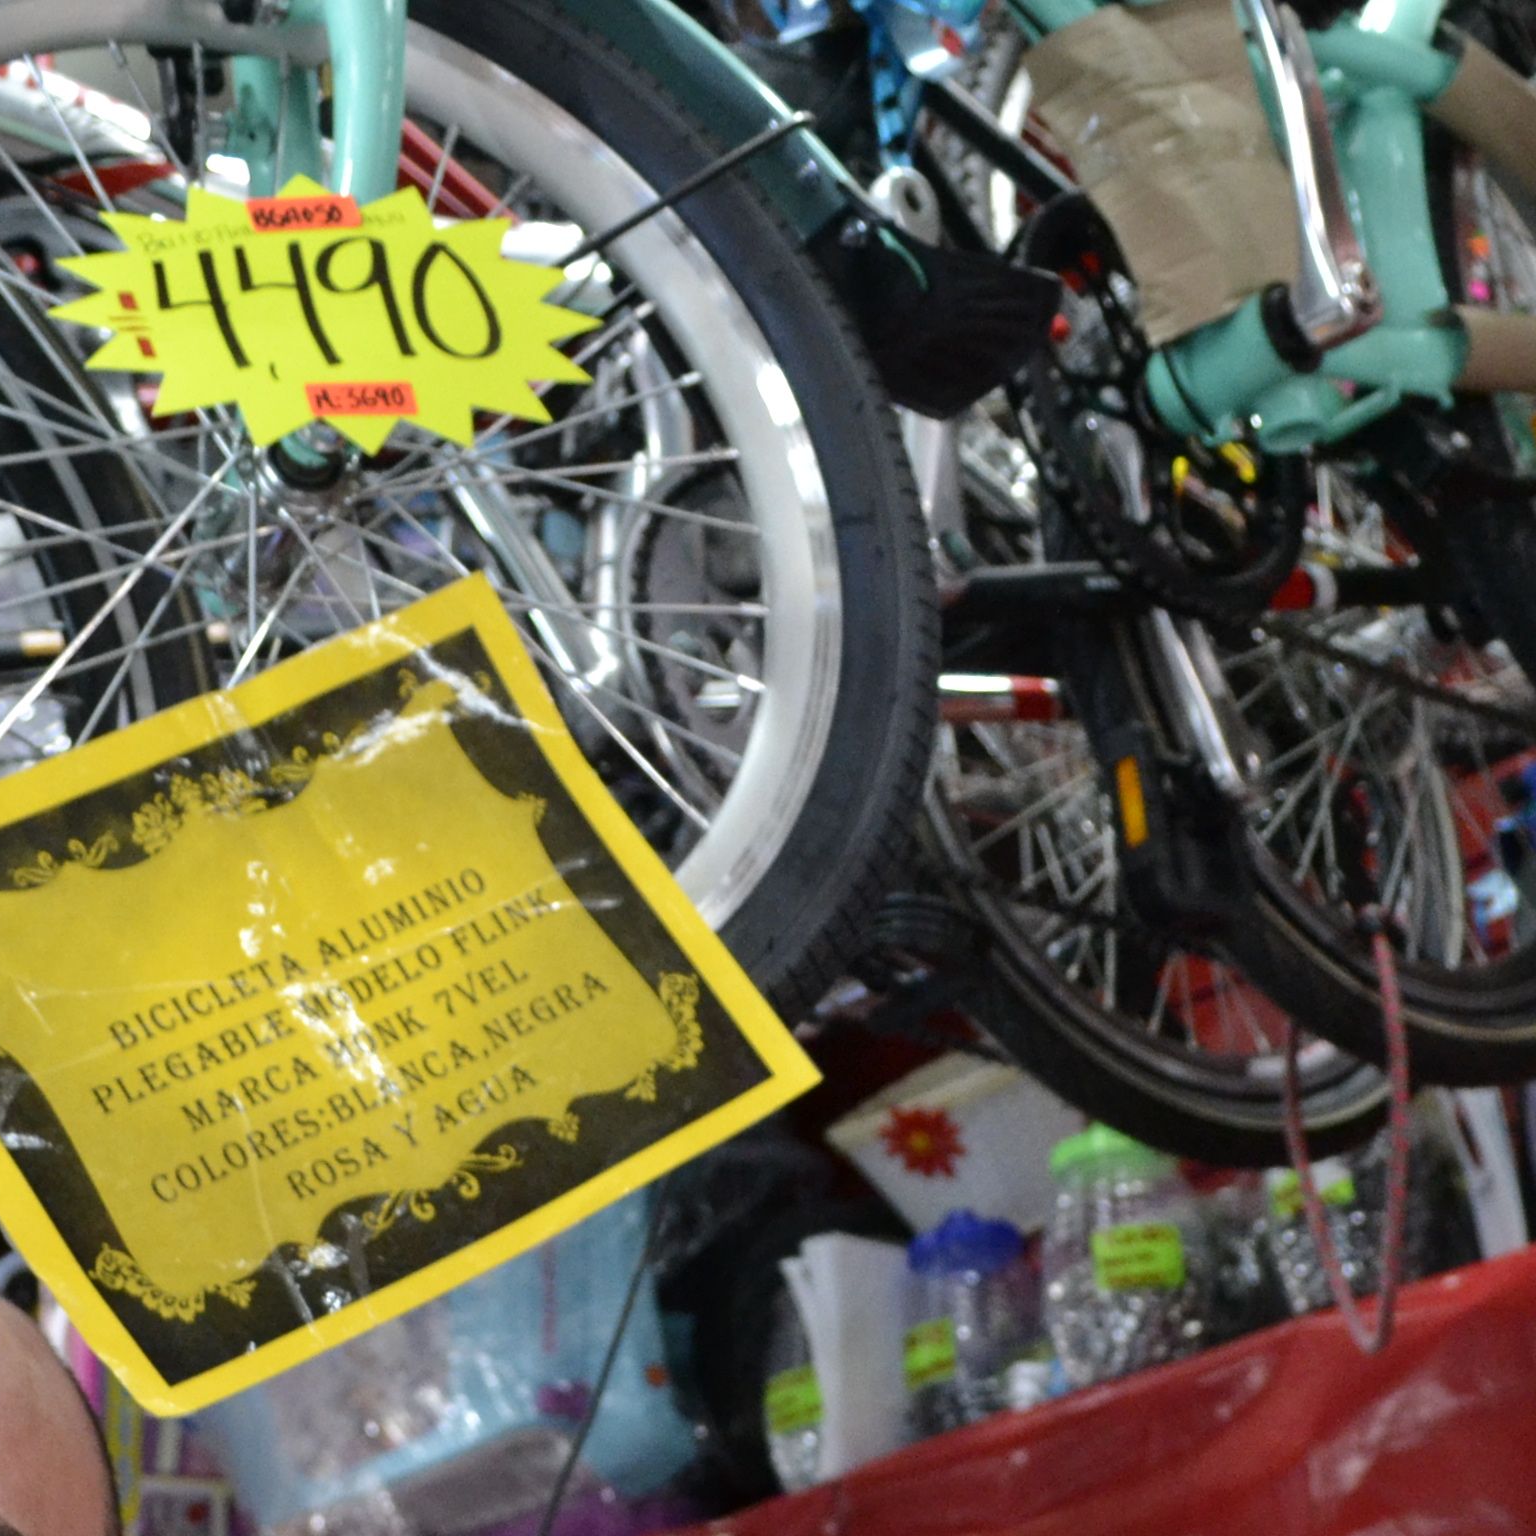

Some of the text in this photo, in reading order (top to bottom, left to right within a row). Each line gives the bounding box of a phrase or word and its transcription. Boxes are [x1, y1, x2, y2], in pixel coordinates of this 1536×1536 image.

[91, 888, 553, 1115] PLEGABLE MODELO FLINK
[108, 867, 486, 1051] BICICLETA ALUMINIO
[181, 957, 531, 1133] MARCA MONK 7VEL
[285, 1061, 539, 1202] ROSA Y AGUA
